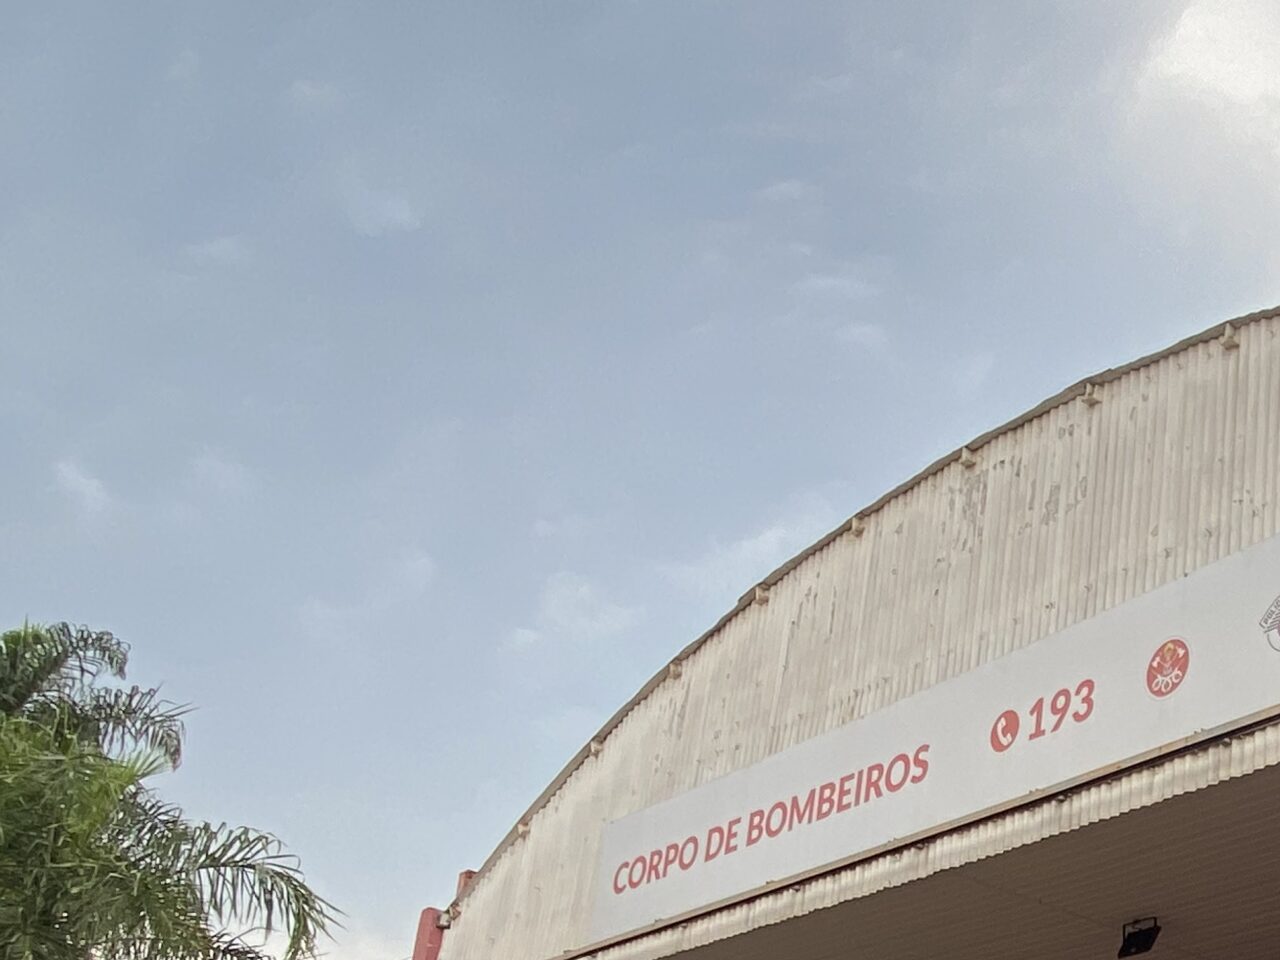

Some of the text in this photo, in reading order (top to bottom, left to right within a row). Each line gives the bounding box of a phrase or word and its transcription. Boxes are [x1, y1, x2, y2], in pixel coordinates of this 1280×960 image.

[1028, 679, 1095, 741] 193
[613, 744, 930, 894] CORPO DE BOMBEIROS
